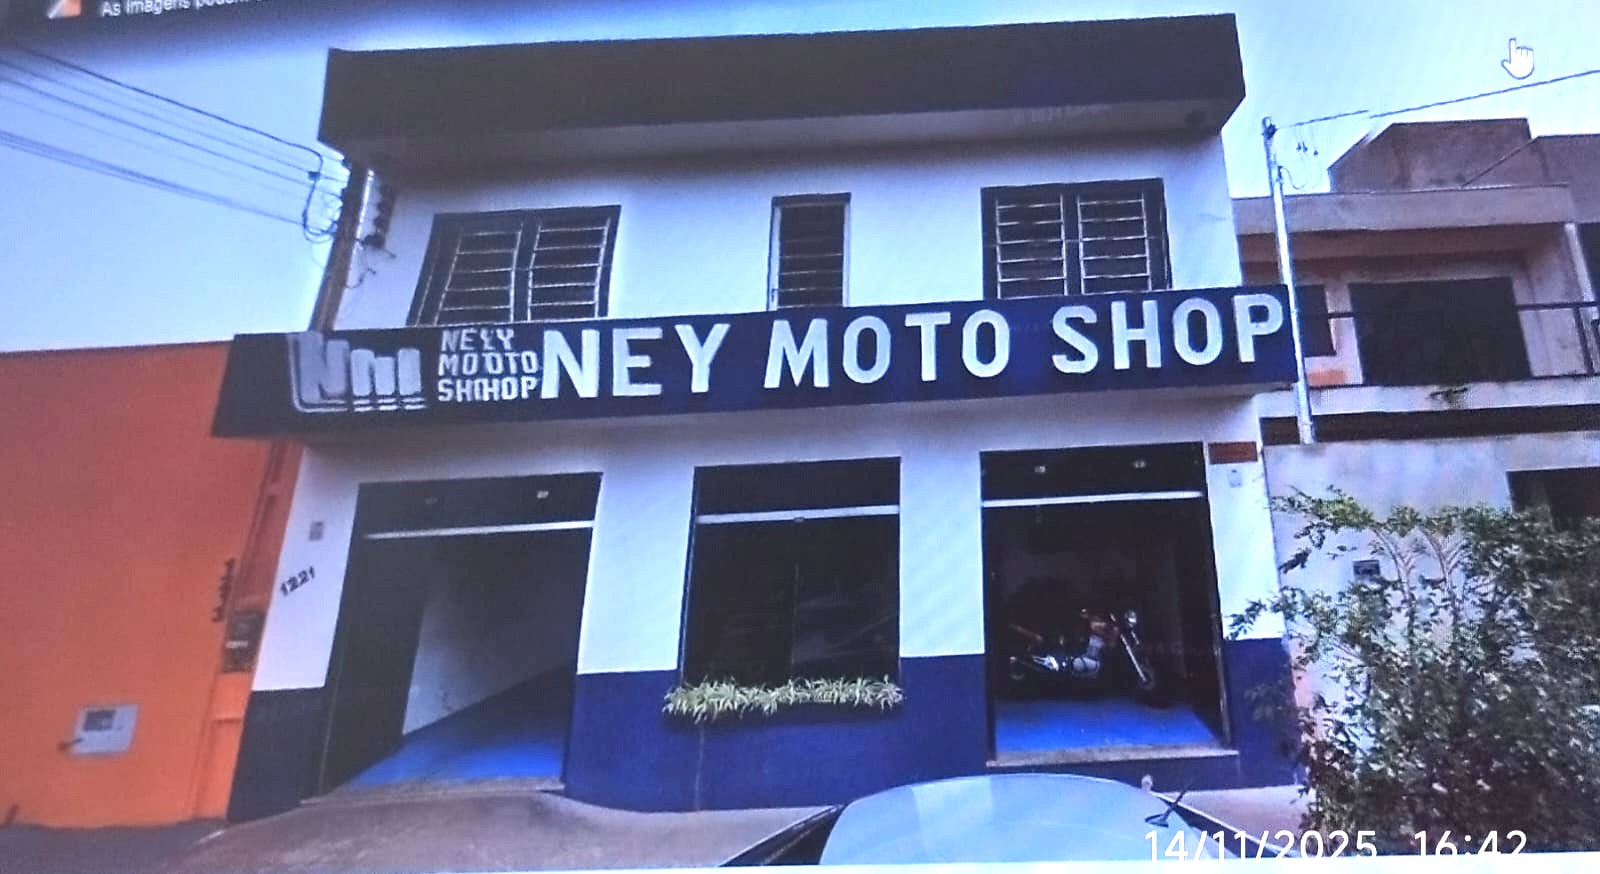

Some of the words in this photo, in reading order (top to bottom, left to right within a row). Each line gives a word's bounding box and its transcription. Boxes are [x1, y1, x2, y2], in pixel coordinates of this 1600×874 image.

[101, 1, 121, 17] As
[540, 323, 730, 400] NEY
[763, 308, 1010, 390] MOTO
[1052, 293, 1285, 374] SHOP
